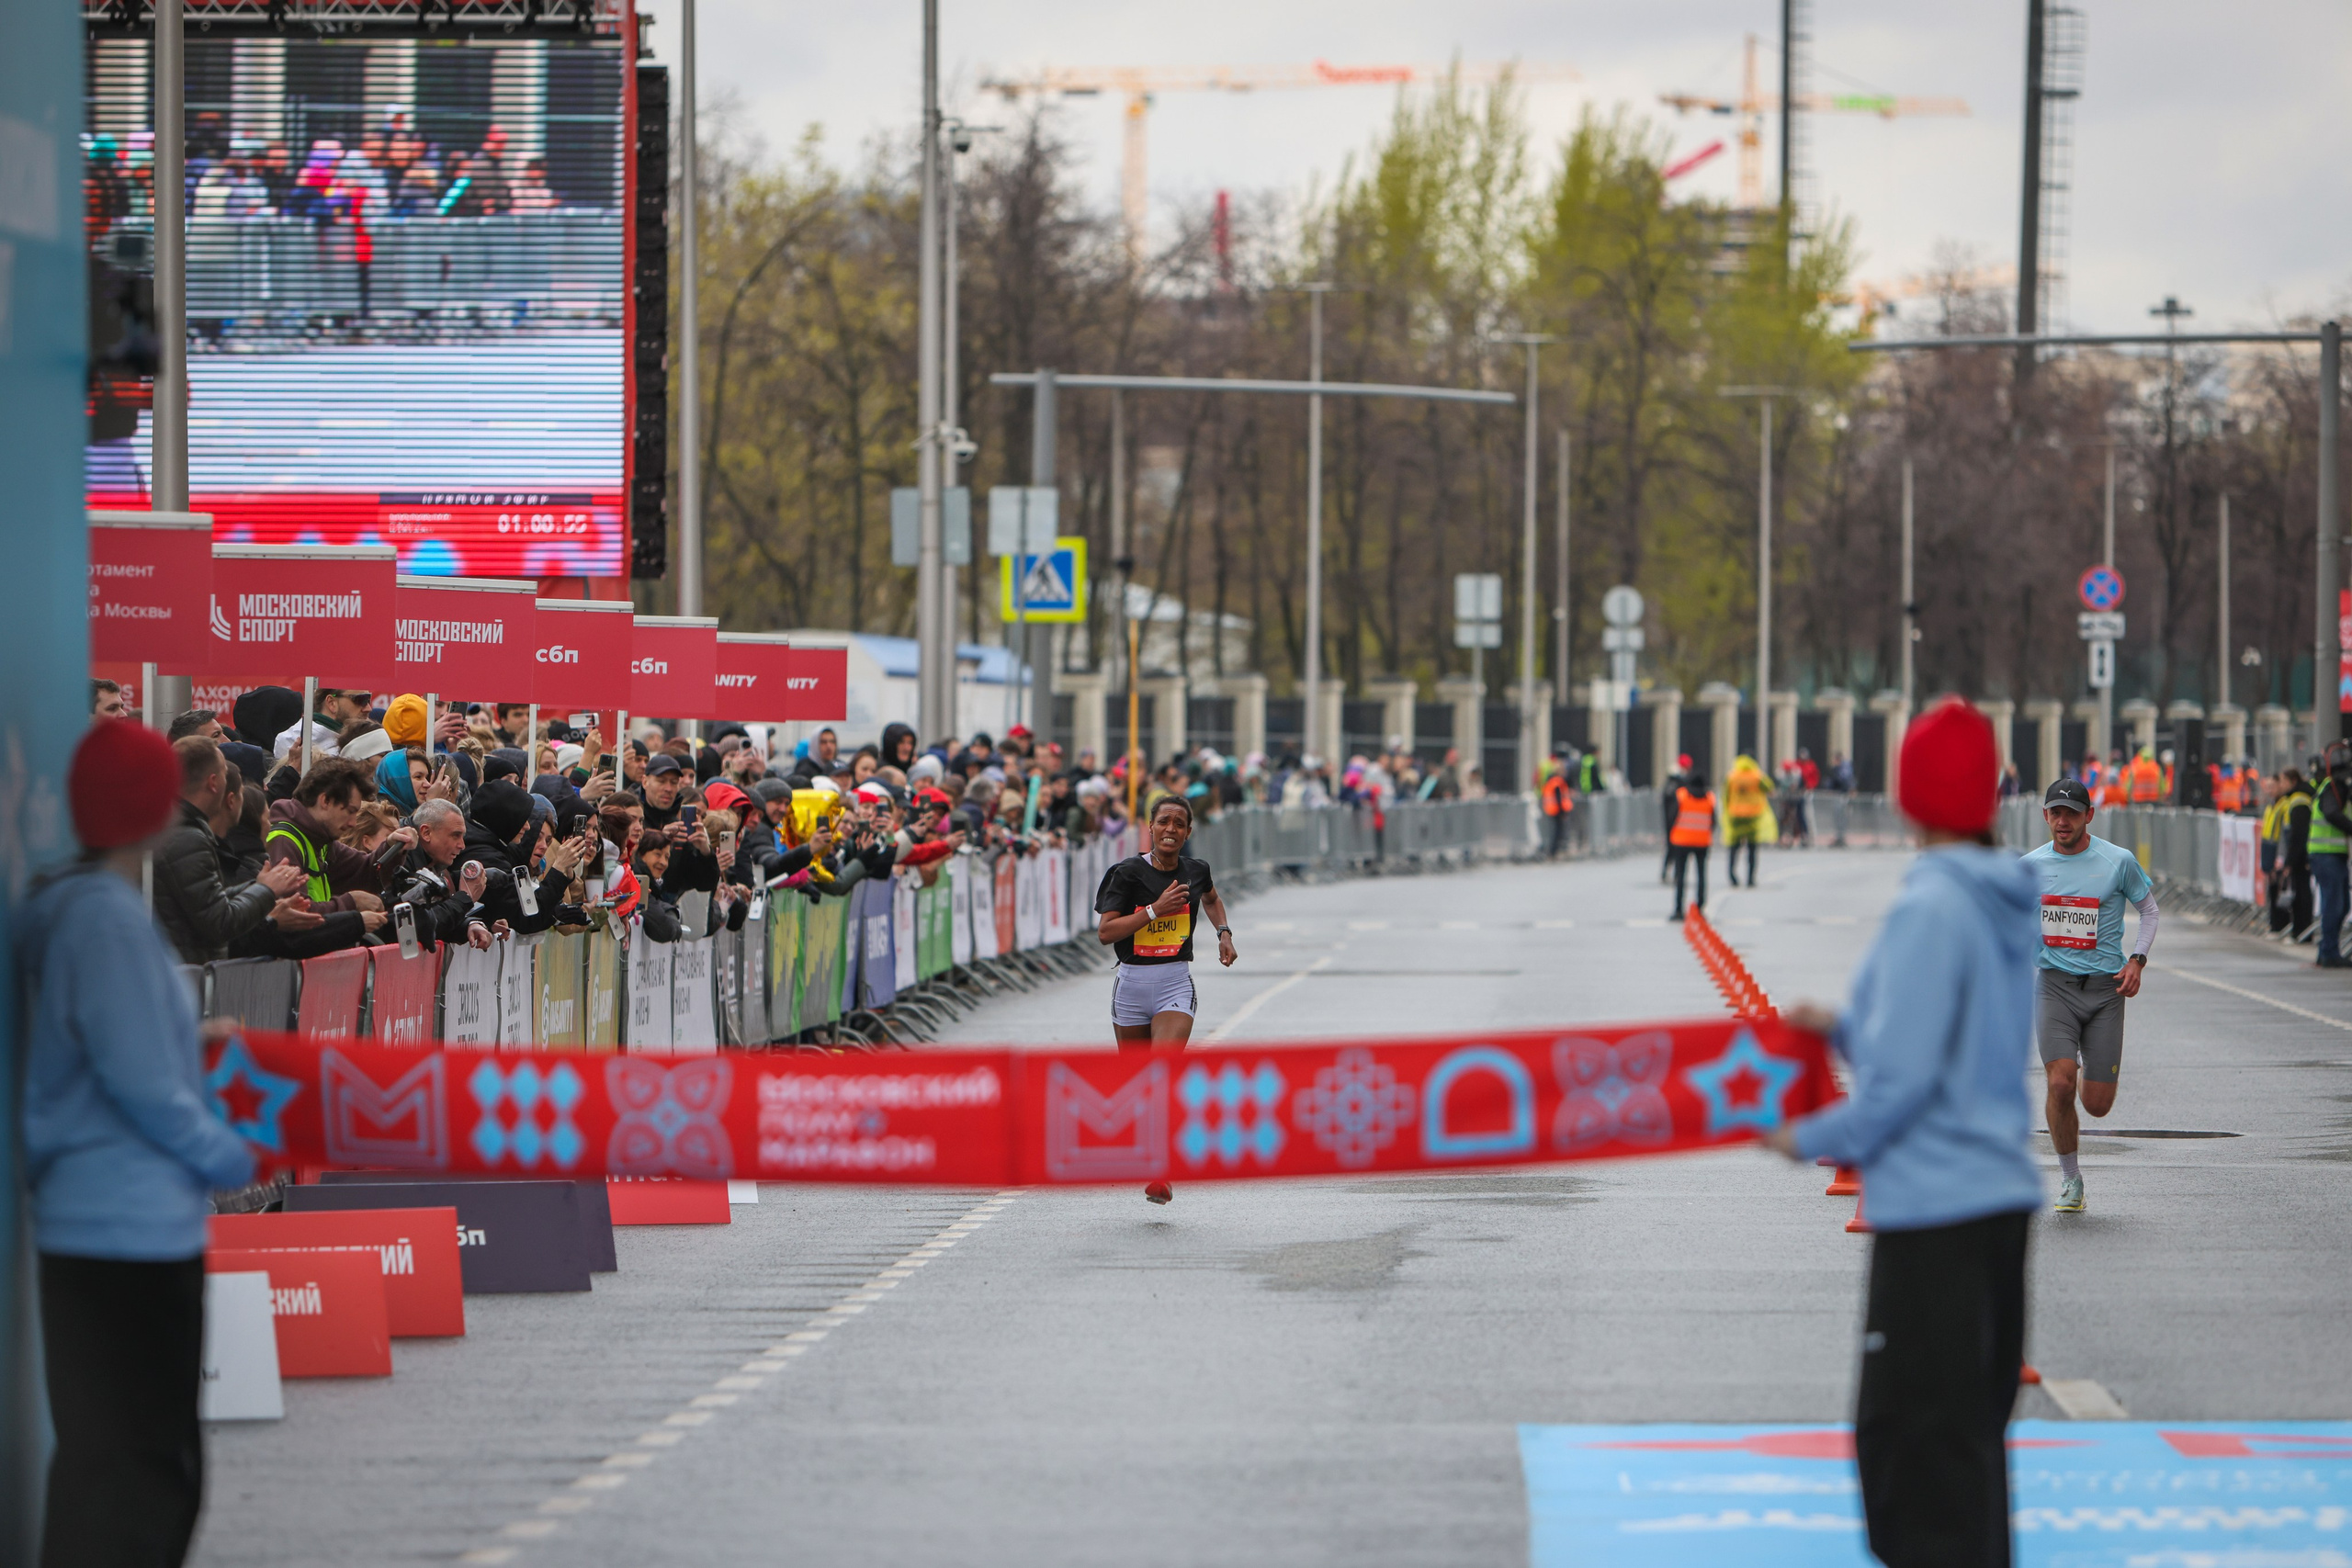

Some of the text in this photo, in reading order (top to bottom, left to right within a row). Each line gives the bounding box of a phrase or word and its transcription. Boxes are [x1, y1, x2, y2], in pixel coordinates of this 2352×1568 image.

[88, 564, 155, 578] тамент
[105, 603, 172, 619] Москвы
[239, 590, 362, 618] МОСКОВСКИЙ
[239, 618, 297, 642] СПОРТ
[395, 618, 503, 644] МОСКОВСКИЙ
[395, 640, 445, 663] СПОРТ
[536, 645, 579, 664] сбп
[631, 657, 668, 674] сбп
[1147, 919, 1177, 933] ALEMU
[2042, 909, 2098, 926] PANFYOROV
